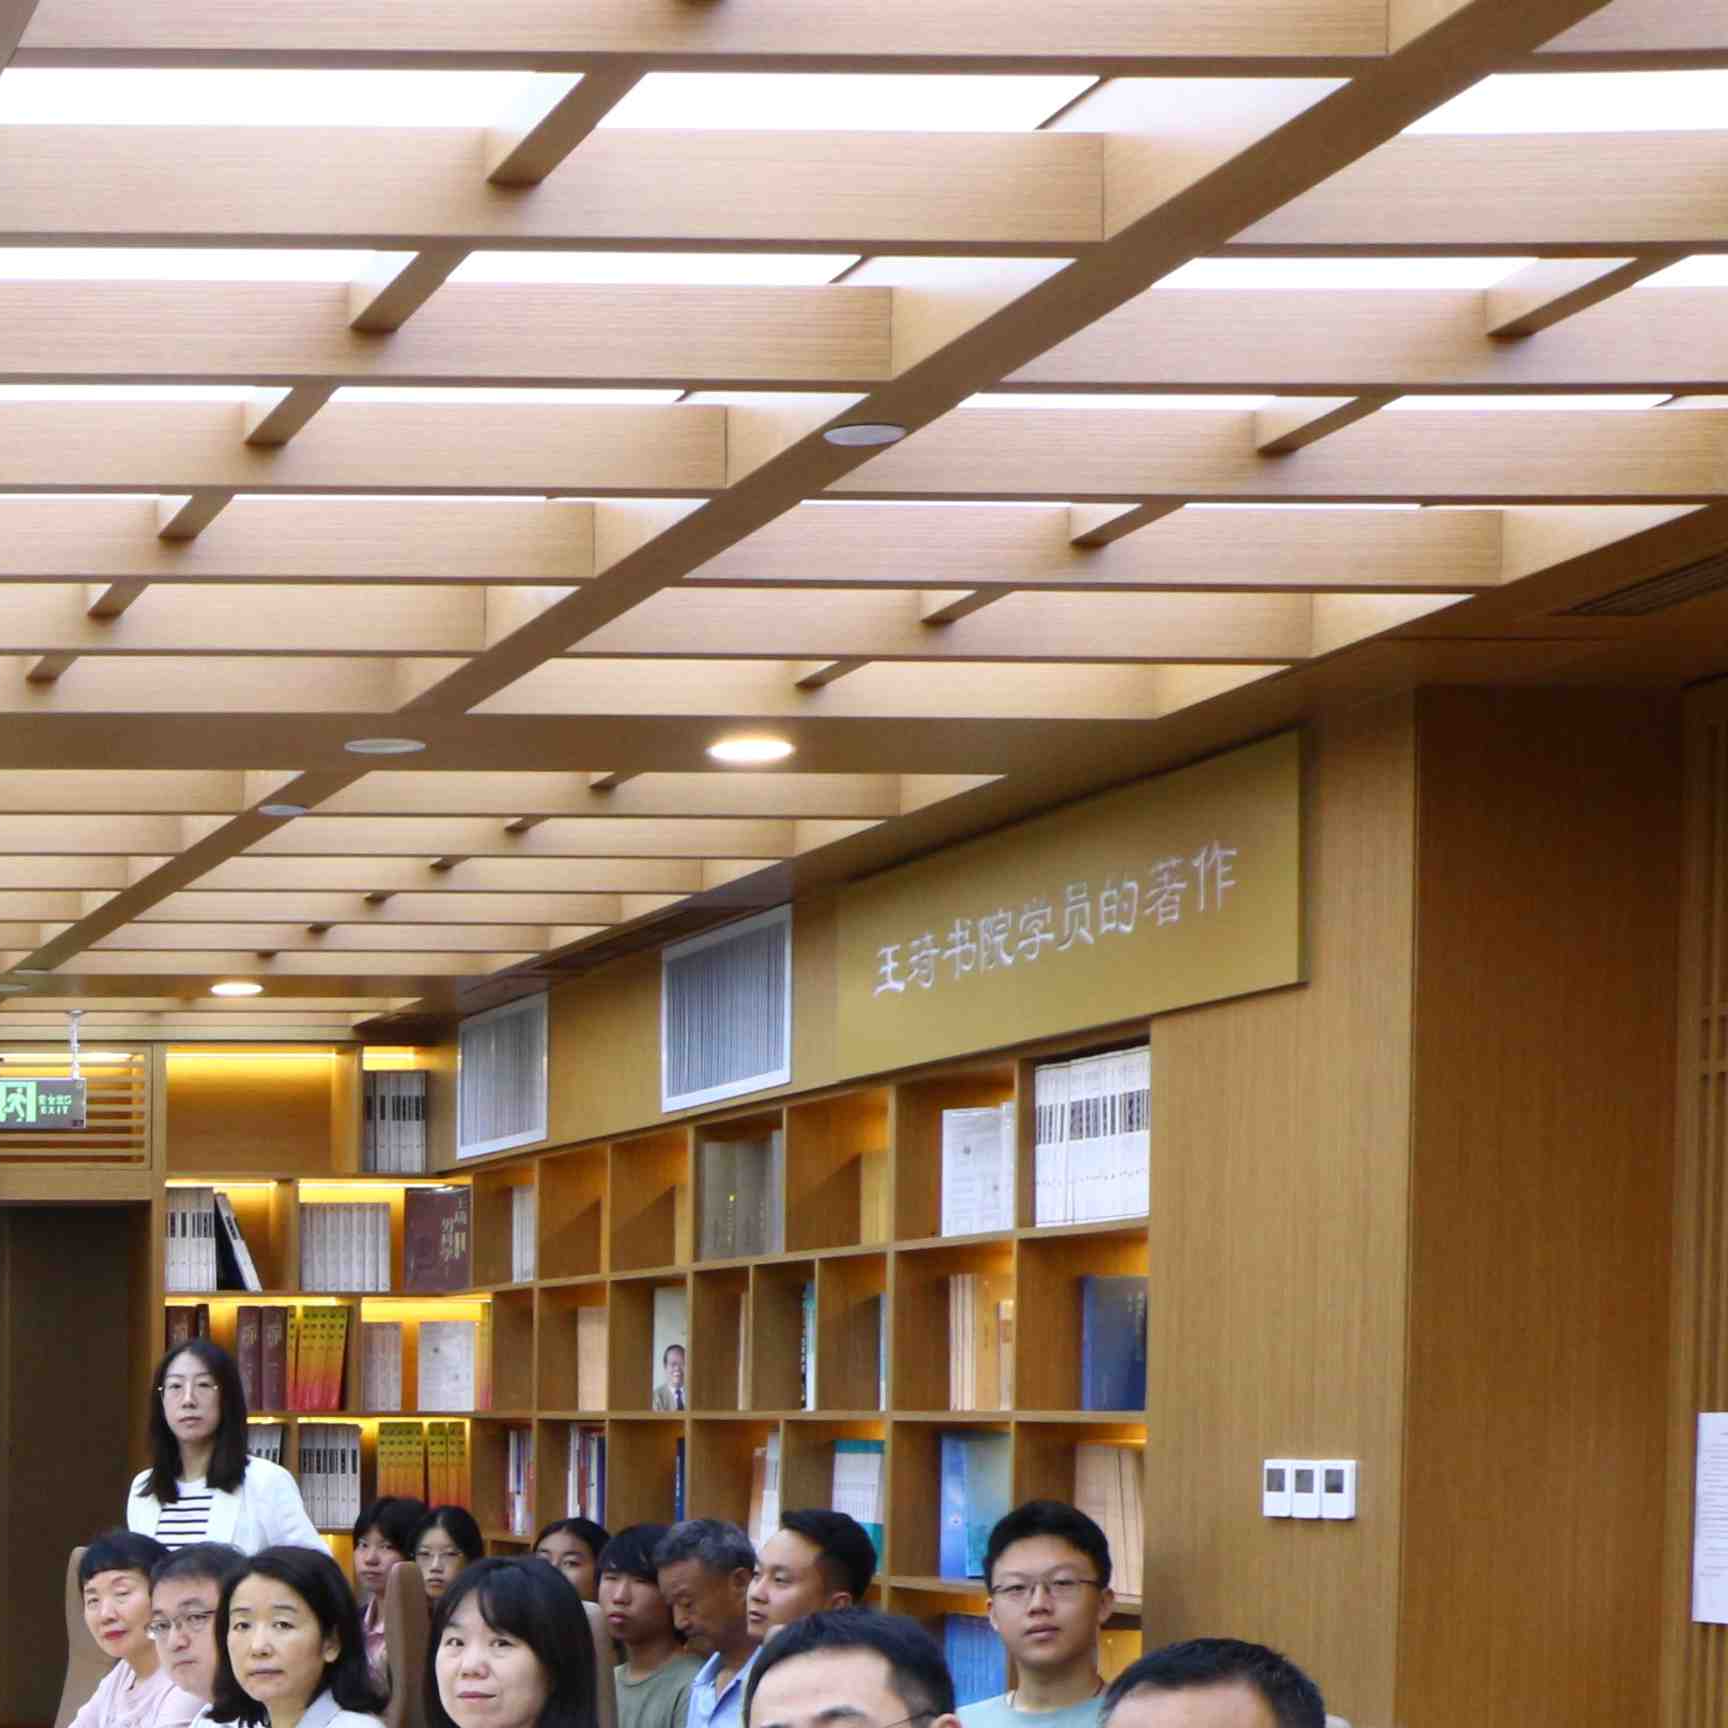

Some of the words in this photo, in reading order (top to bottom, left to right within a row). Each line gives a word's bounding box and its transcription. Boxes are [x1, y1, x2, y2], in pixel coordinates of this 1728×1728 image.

[873, 839, 1238, 998] 王琦书院学员的著作
[40, 1105, 70, 1115] EXIT
